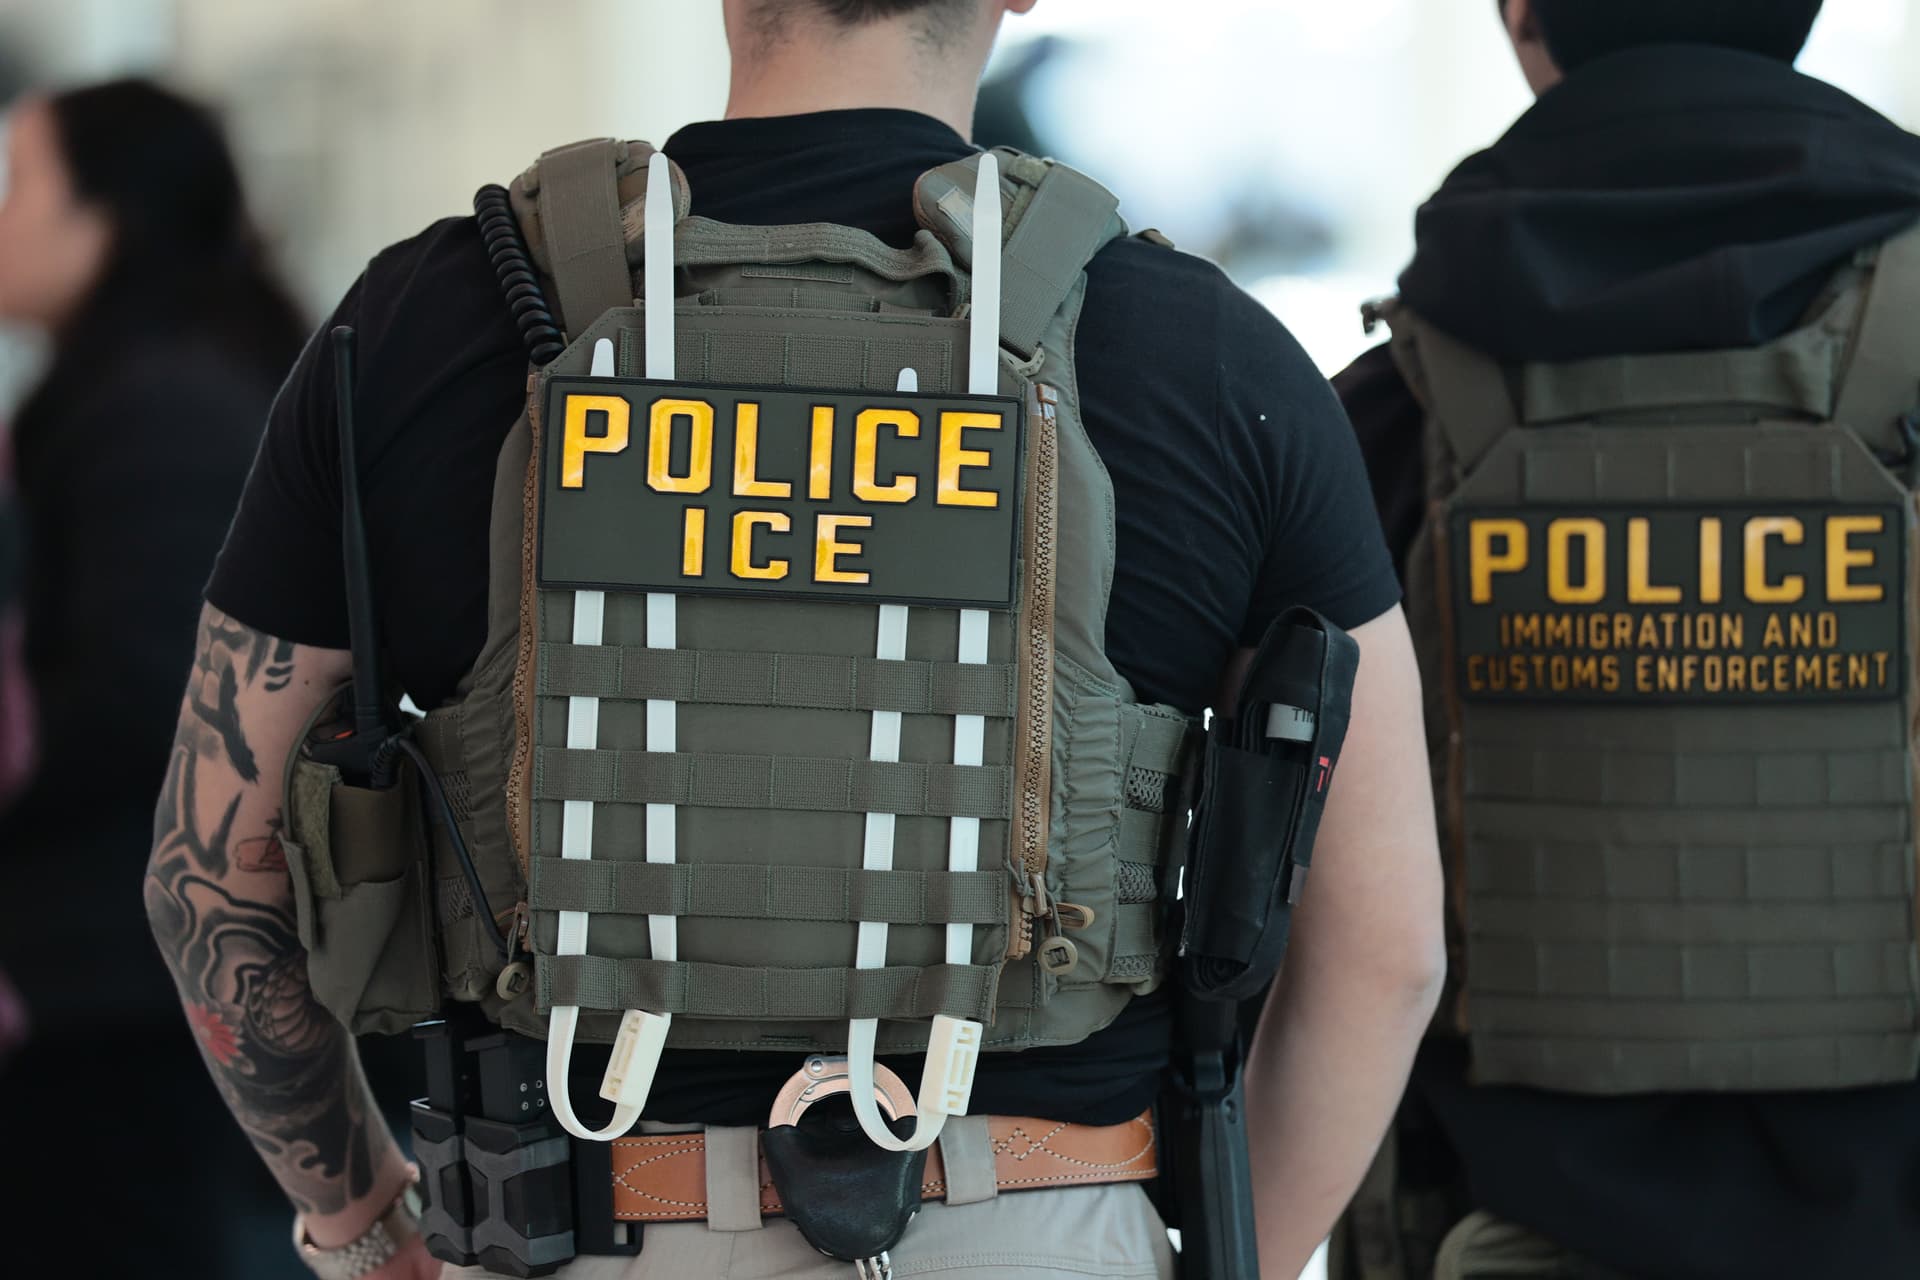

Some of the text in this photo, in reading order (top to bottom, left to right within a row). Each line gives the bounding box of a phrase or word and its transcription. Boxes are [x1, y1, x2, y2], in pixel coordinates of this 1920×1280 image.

[562, 394, 1002, 507] POLICE
[682, 507, 872, 583] ICE
[1470, 516, 1883, 604] POLICE
[1501, 612, 1838, 649] IMMIGRATION AND
[1468, 651, 1888, 692] CUSTOMS ENFORCEMENT
